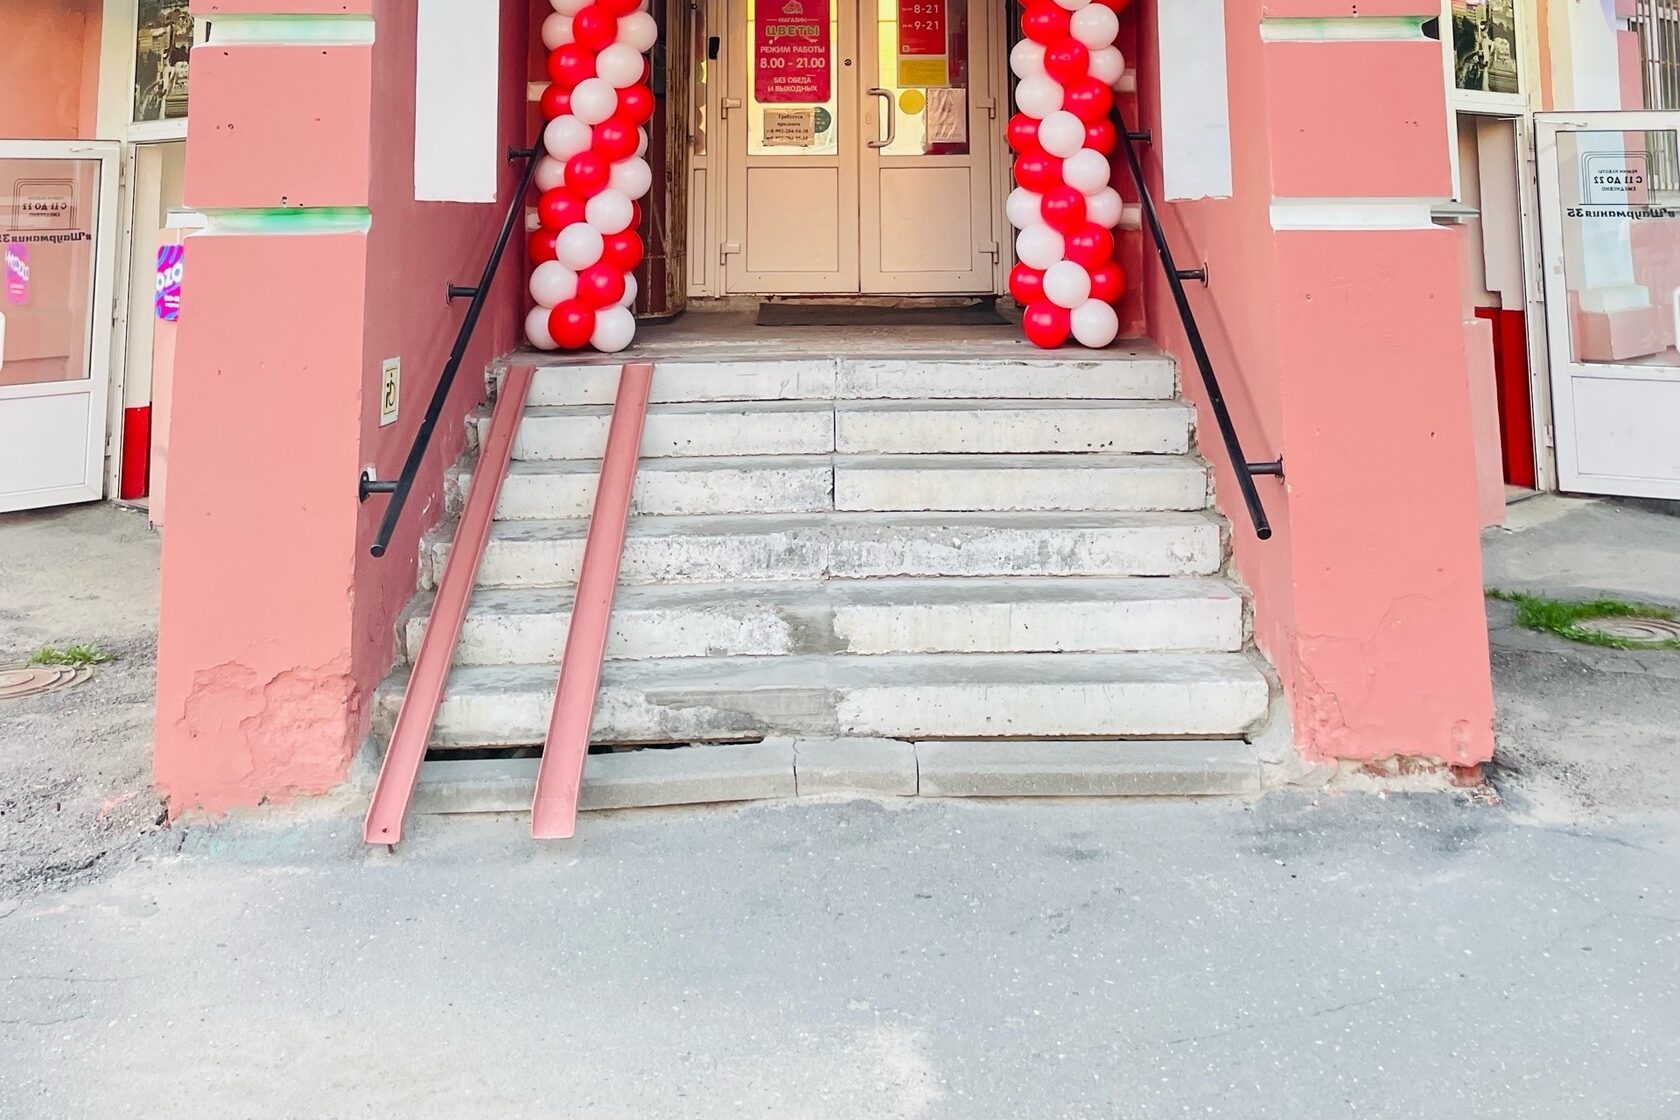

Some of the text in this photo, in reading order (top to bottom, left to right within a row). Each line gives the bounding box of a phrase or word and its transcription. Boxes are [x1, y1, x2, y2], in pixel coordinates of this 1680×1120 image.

[914, 4, 938, 14] 8-21
[914, 20, 939, 30] 9-21
[766, 25, 820, 37] ЦВЕТЫ
[760, 57, 785, 68] 8.00
[796, 57, 826, 68] 21.00
